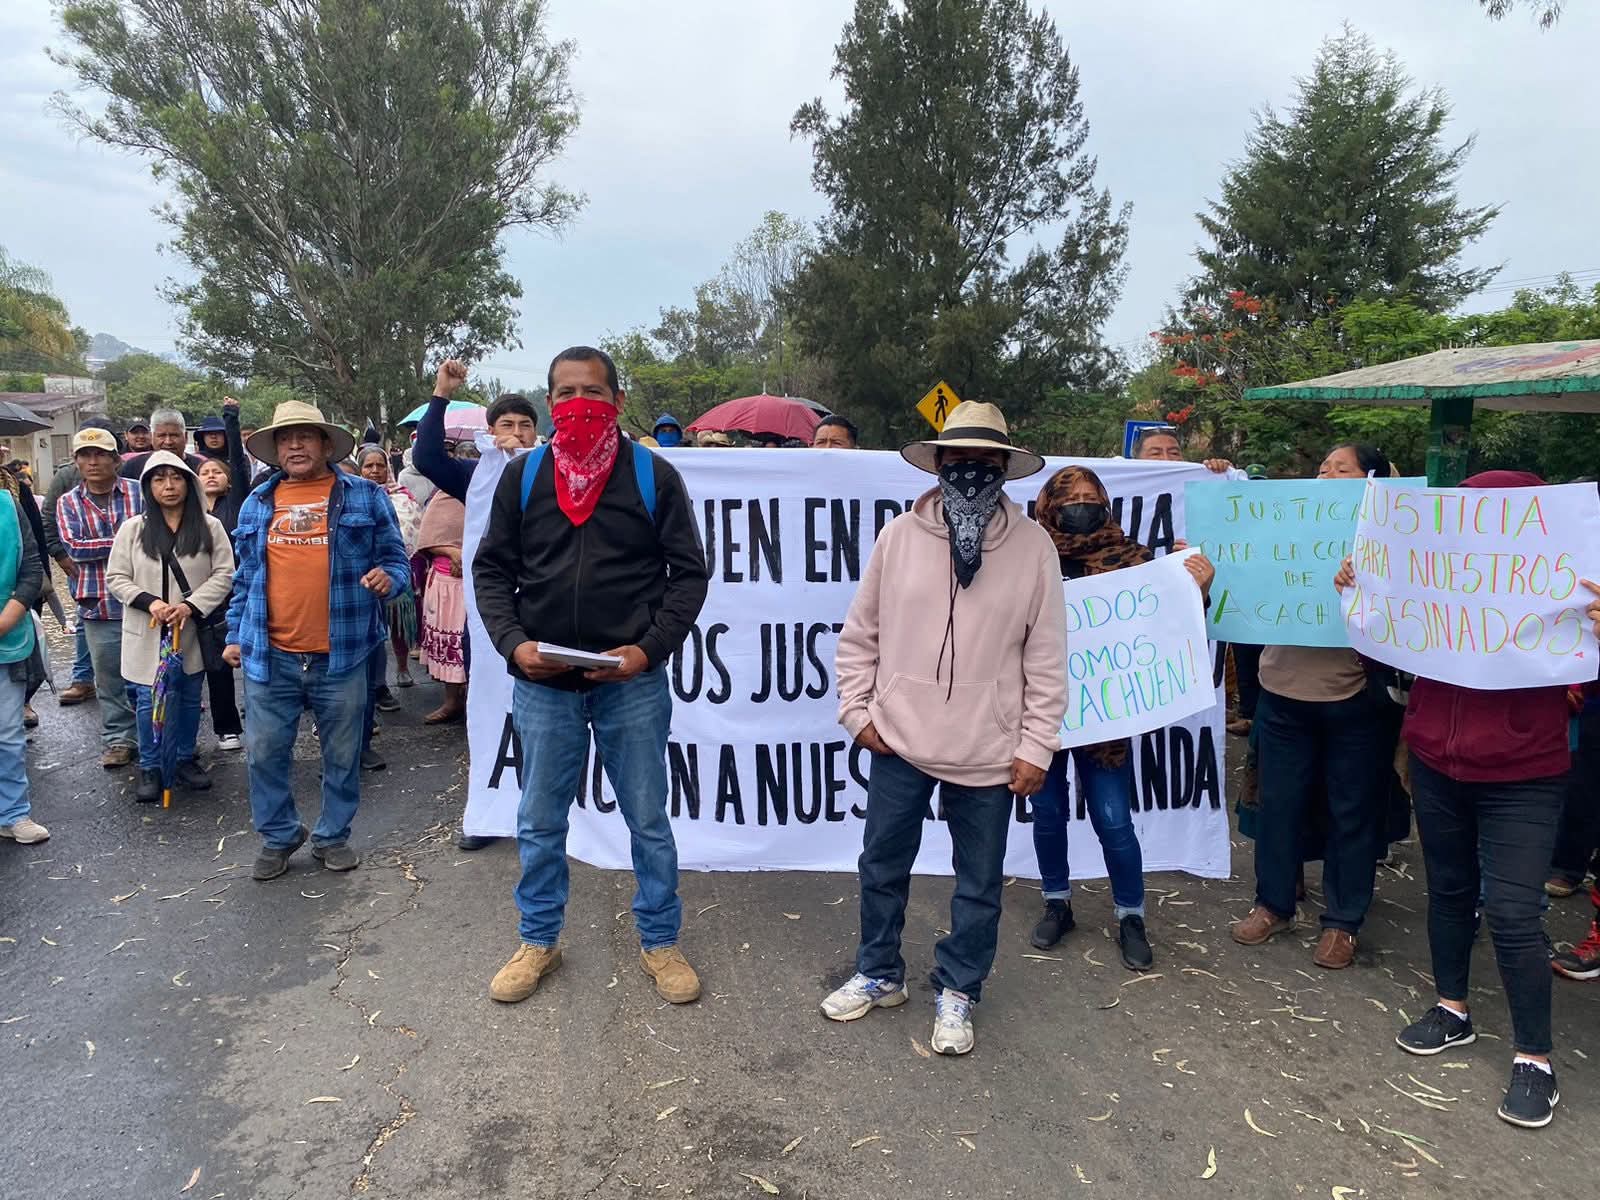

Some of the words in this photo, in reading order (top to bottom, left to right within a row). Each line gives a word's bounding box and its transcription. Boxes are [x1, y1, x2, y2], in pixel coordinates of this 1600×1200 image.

[804, 497, 861, 583] EN
[1360, 482, 1549, 540] JUSTICIA
[1356, 534, 1391, 581] PARA
[1409, 548, 1577, 601] NUESTROS
[1065, 583, 1160, 633] ODOS
[1213, 589, 1332, 627] ACACH
[671, 622, 732, 705] OS
[1068, 634, 1157, 681] OMOS
[714, 743, 746, 826] A
